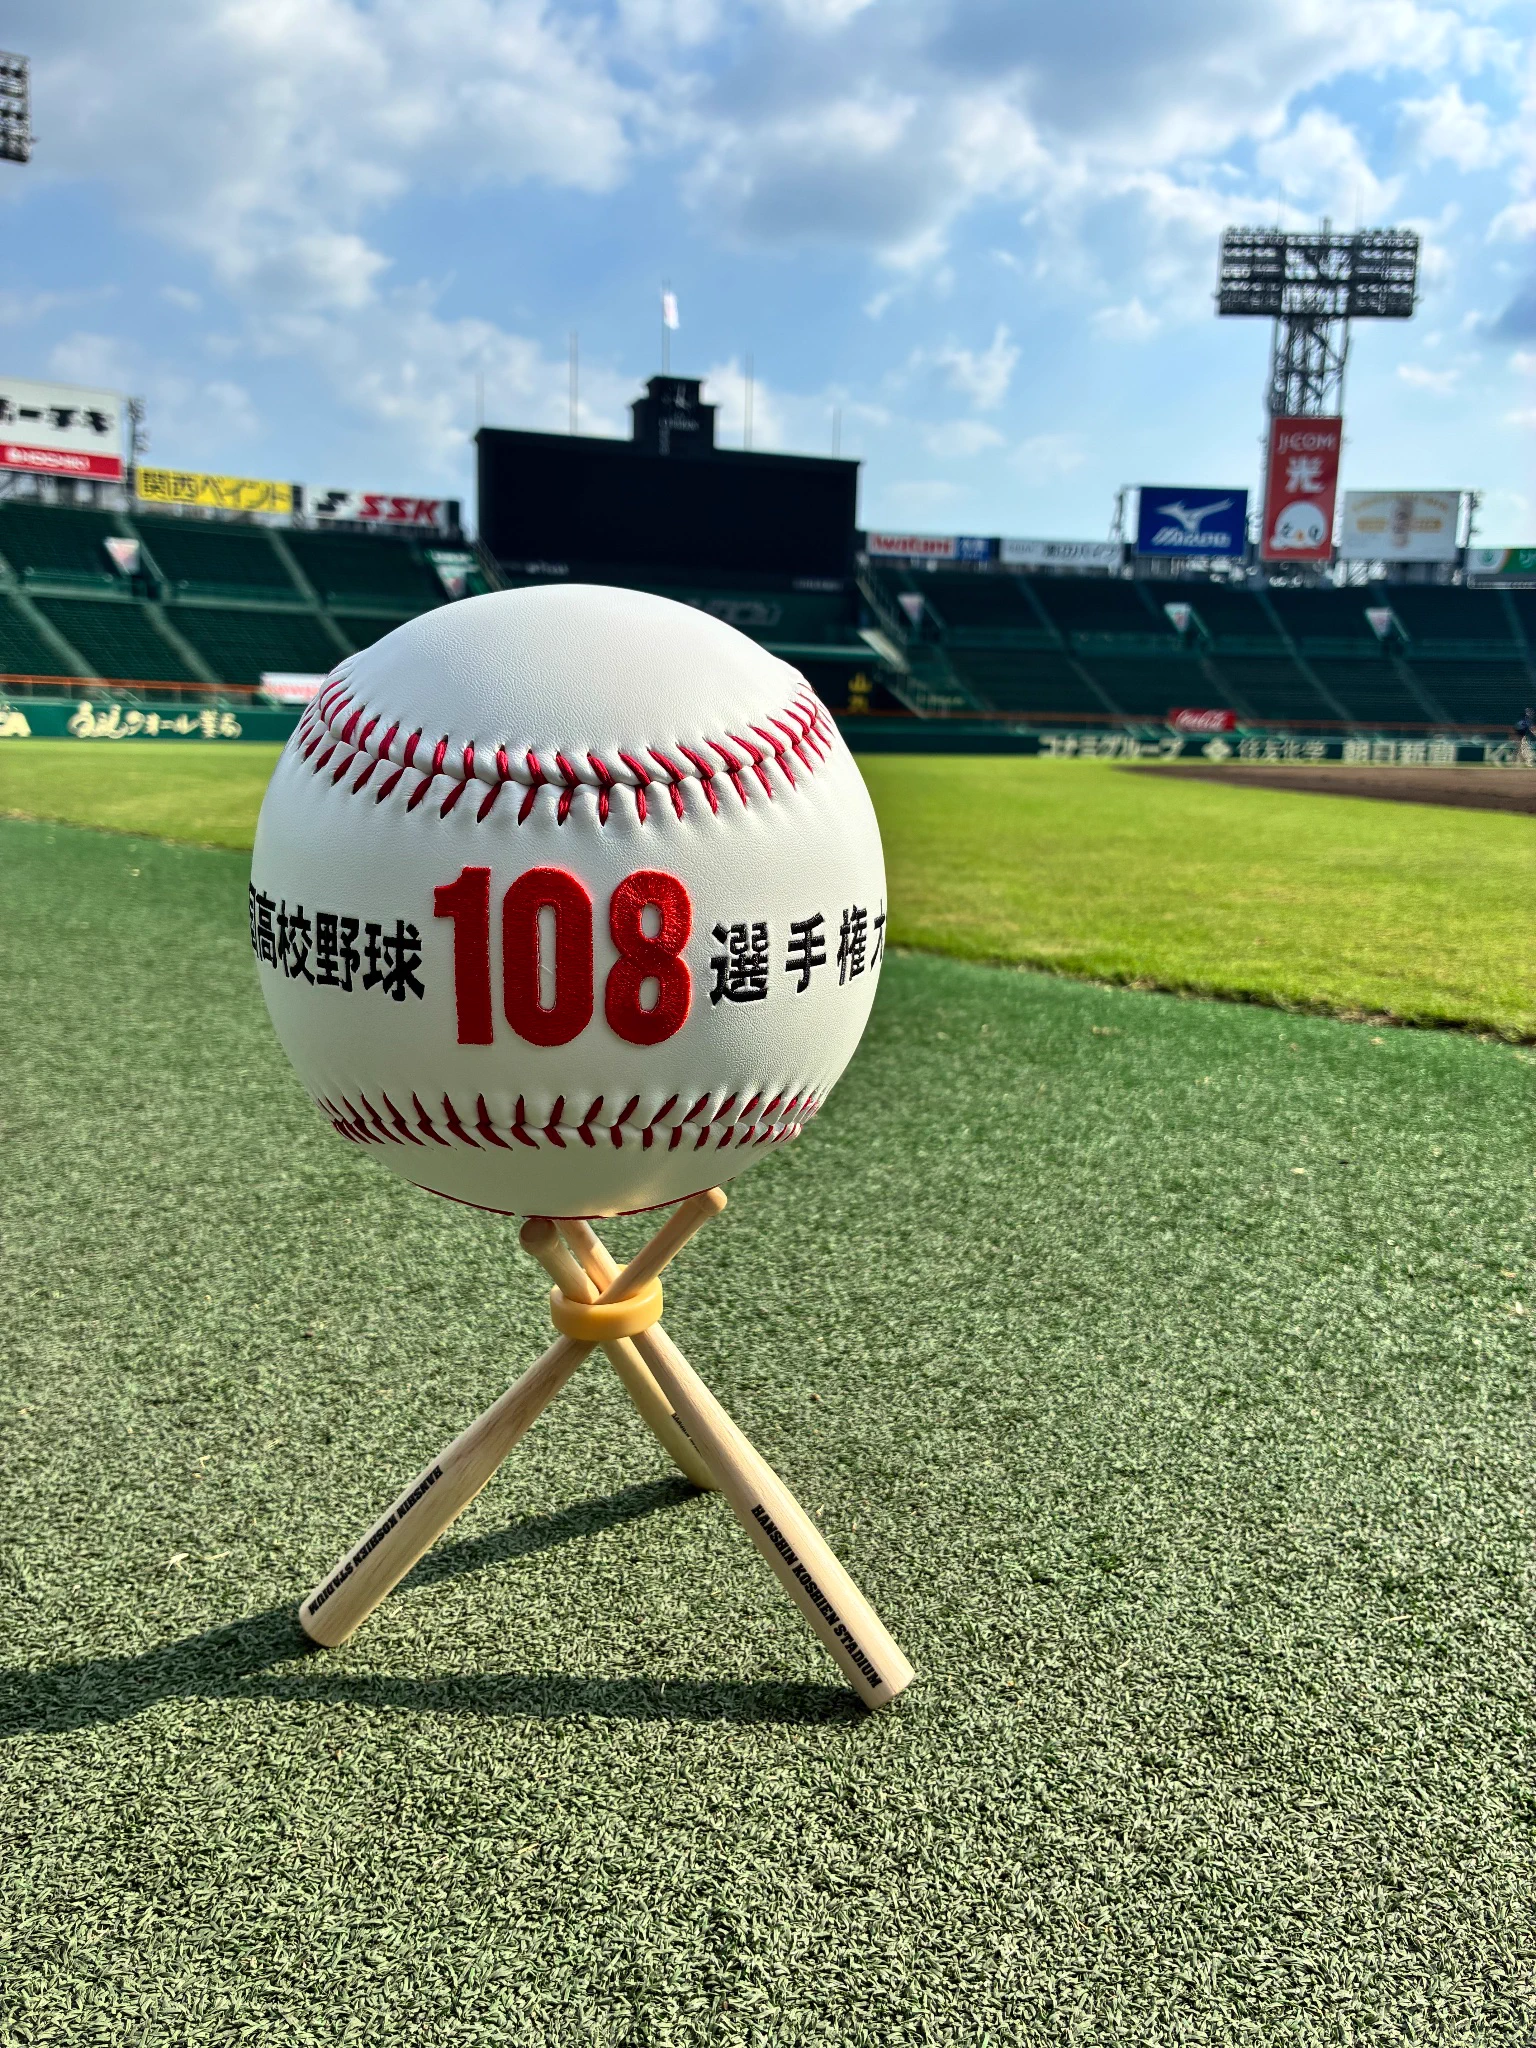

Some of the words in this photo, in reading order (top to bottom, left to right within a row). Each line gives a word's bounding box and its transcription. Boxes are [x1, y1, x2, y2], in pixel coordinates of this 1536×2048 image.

[142, 471, 291, 511] 関西ペイント
[1285, 456, 1325, 493] 光
[358, 495, 440, 526] SSK
[1038, 735, 1187, 761] コナミグループ
[1238, 737, 1326, 761] 住友化学
[1342, 738, 1458, 763] 朝日新聞
[434, 866, 692, 1046] 108
[397, 1464, 443, 1519] HANSHIN
[352, 1513, 398, 1567] KOSHIEN
[307, 1561, 354, 1616] STADIUM
[750, 1503, 799, 1566] HANSHIN
[792, 1563, 841, 1626] KOSHIEN
[833, 1623, 883, 1688] STADIUM
